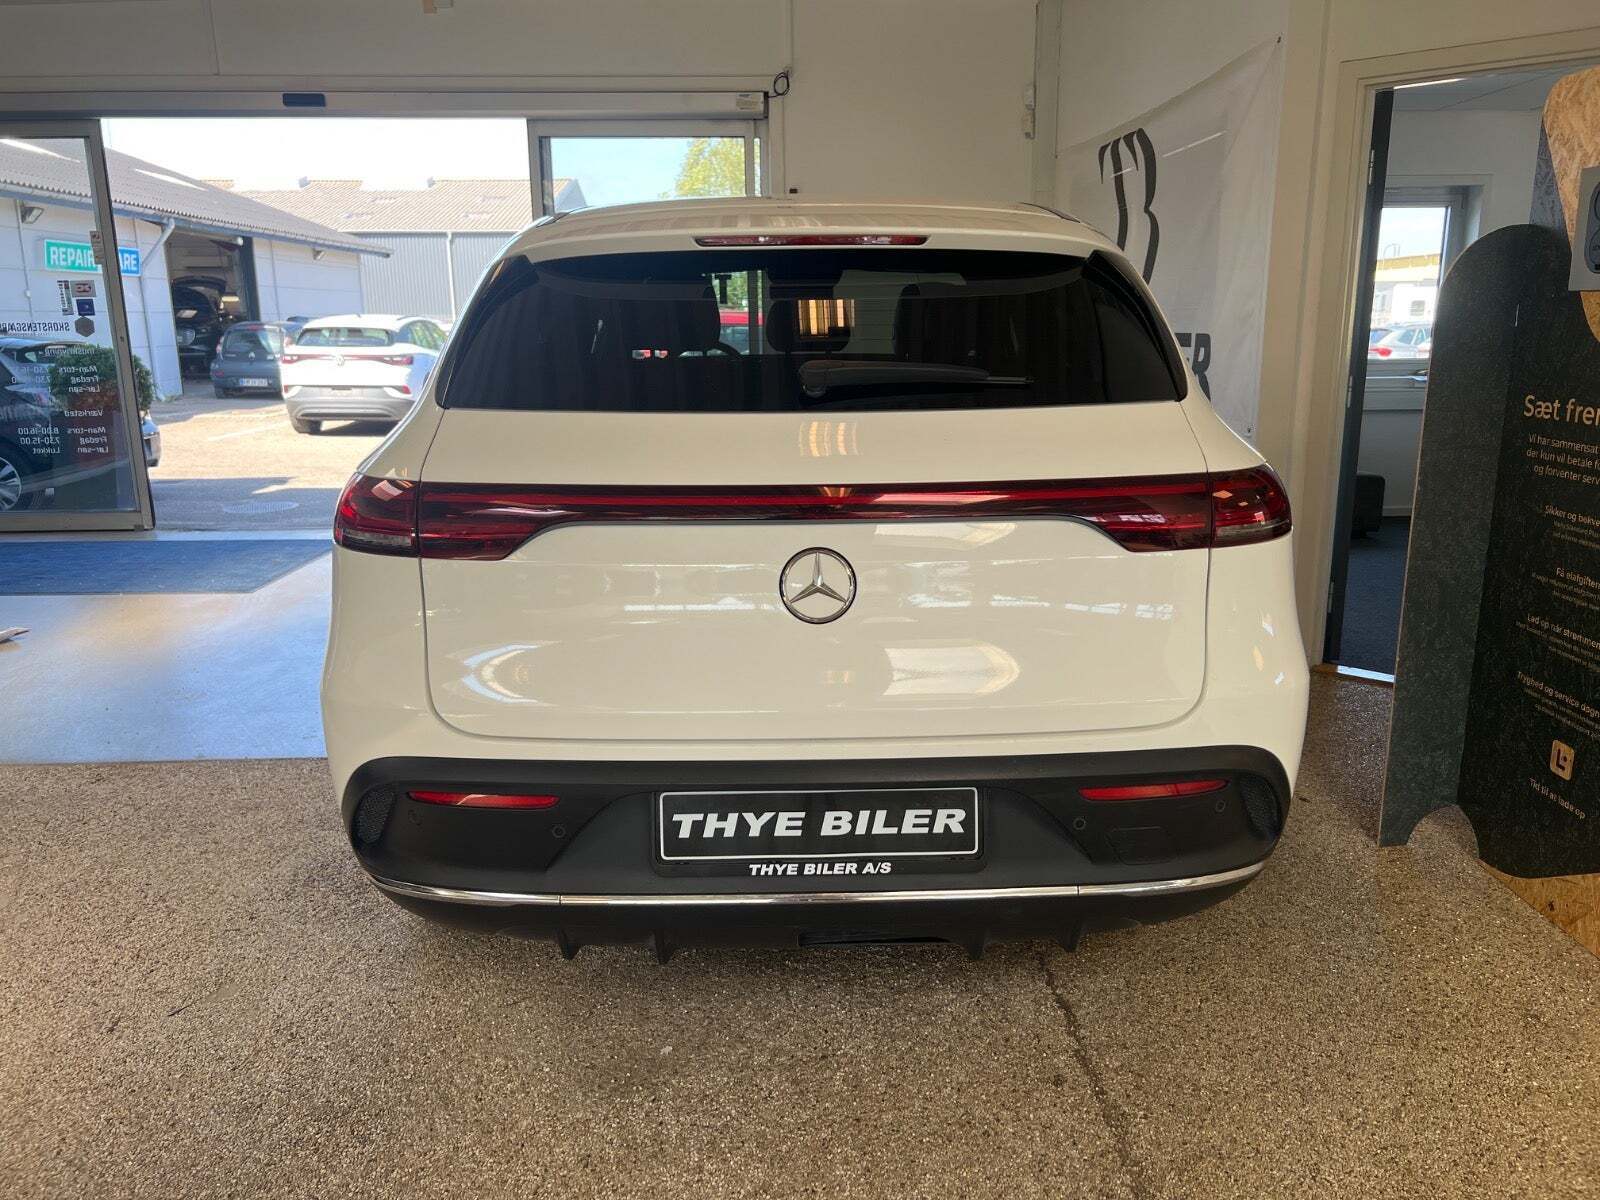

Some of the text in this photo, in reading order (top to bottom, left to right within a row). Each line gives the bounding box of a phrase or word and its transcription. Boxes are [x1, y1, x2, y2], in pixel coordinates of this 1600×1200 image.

[1523, 395, 1561, 421] Sæt
[1551, 439, 1599, 454] sammensat
[1526, 448, 1539, 458] der
[1567, 454, 1593, 469] betale
[1534, 465, 1544, 476] og
[1544, 465, 1582, 481] forventer
[1545, 504, 1566, 519] Sikker
[1567, 512, 1577, 523] og
[1556, 567, 1566, 577] Få
[1527, 613, 1540, 625] Lad
[1517, 671, 1544, 690] Tryghed
[1544, 686, 1554, 697] og
[1554, 689, 1580, 708] service
[1575, 808, 1586, 820] op
[672, 808, 967, 839] THYE BILER
[749, 862, 892, 876] THYE BILER A/S
